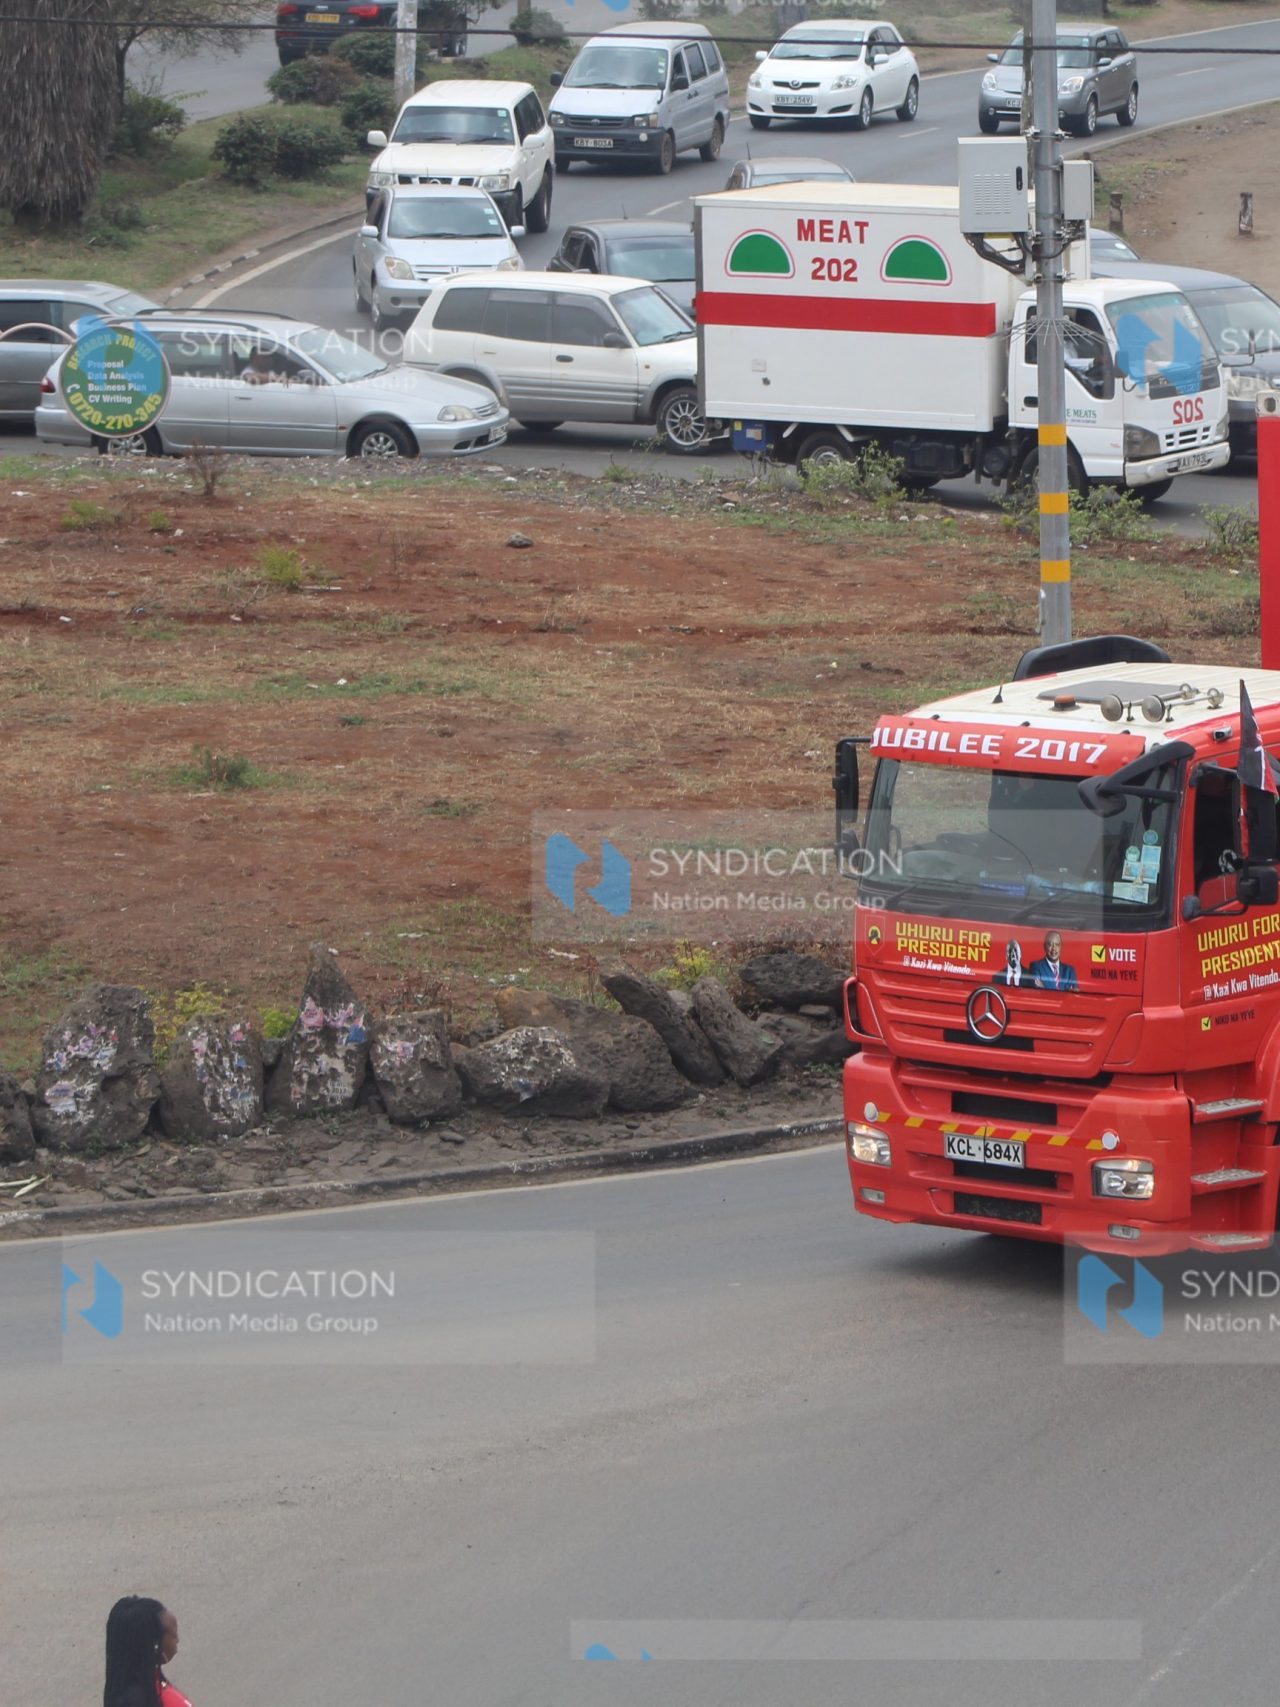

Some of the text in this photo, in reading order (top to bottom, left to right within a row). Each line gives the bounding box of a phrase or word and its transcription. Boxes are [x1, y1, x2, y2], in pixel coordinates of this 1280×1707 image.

[797, 218, 869, 244] MEAT
[811, 257, 858, 282] 202
[87, 360, 124, 370] Proposal
[87, 371, 108, 380] Data
[87, 382, 147, 392] Business Plan
[88, 394, 133, 405] CV Writing
[1072, 408, 1097, 419] MEATS
[870, 727, 1108, 764] JUBILEE 2017
[895, 921, 992, 948] UHURU FOR
[1197, 913, 1280, 953] UHURU FOR
[897, 937, 990, 963] PRESIDENT
[1109, 948, 1137, 963] VOTE
[1201, 940, 1280, 978] PRESIDENT
[910, 956, 926, 970] Kazi
[926, 959, 943, 972] Kwa
[1204, 985, 1212, 1000] @
[1212, 982, 1230, 999] Kazi
[1230, 978, 1248, 995] Kwa
[947, 1136, 1021, 1163] KCL 684X
